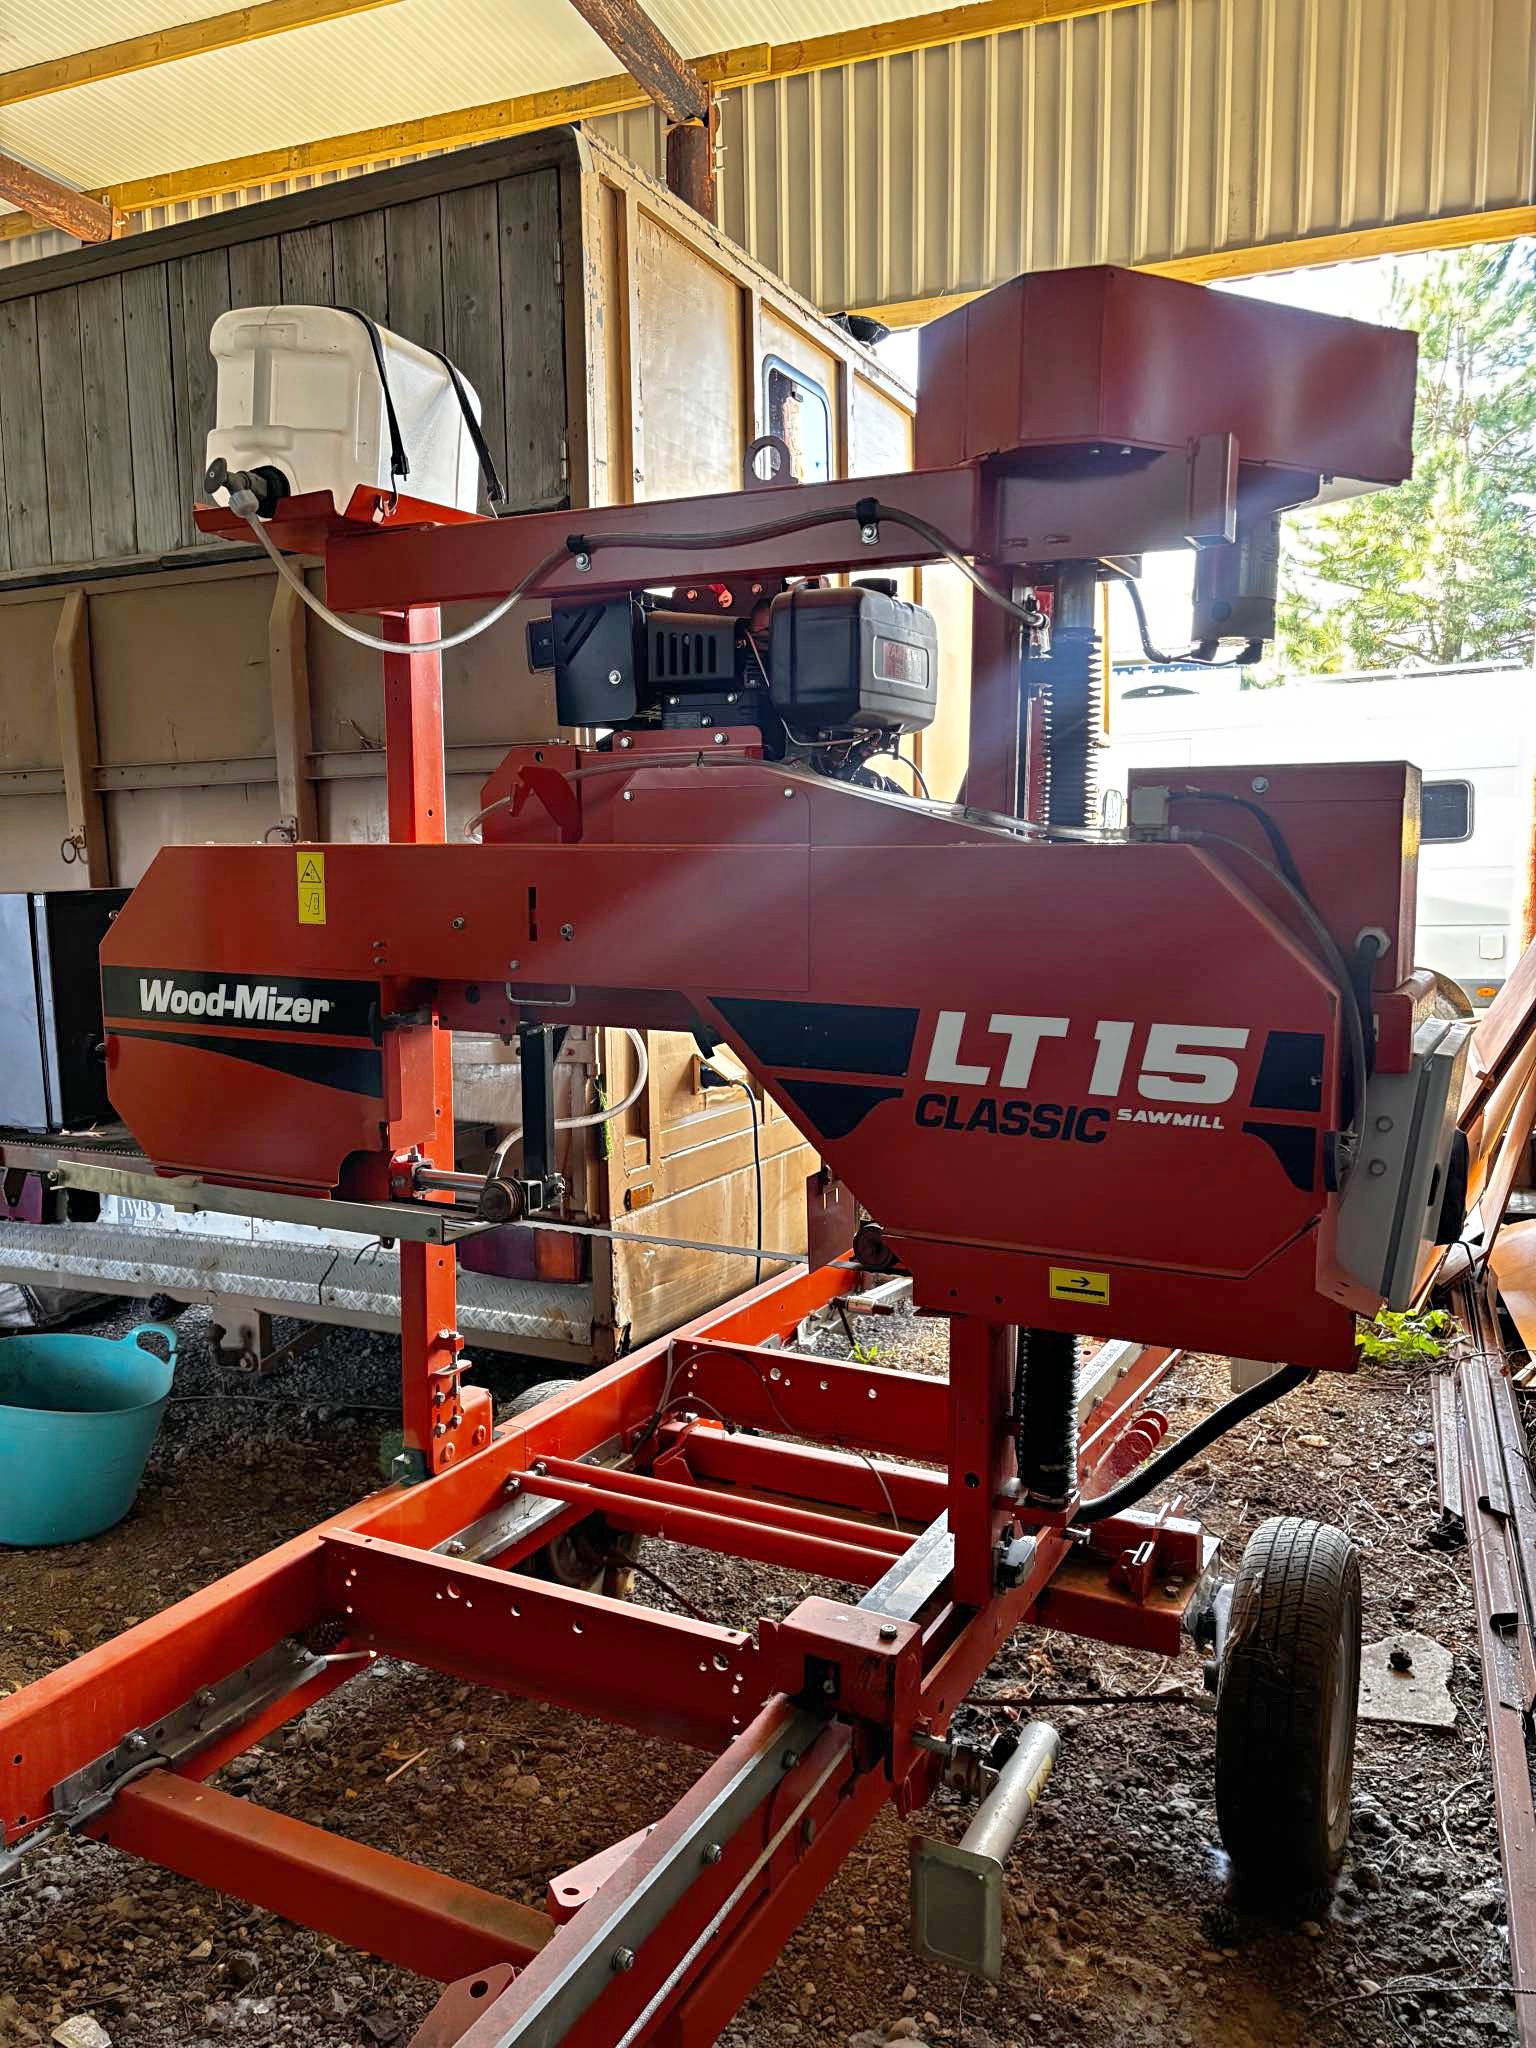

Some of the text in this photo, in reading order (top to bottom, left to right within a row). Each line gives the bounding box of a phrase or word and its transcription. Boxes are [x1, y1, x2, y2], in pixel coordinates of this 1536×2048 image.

[139, 978, 330, 1024] Wood-Mizer
[924, 1010, 1251, 1104] LT 15
[915, 1093, 1225, 1144] CLASSIC SAWMILL
